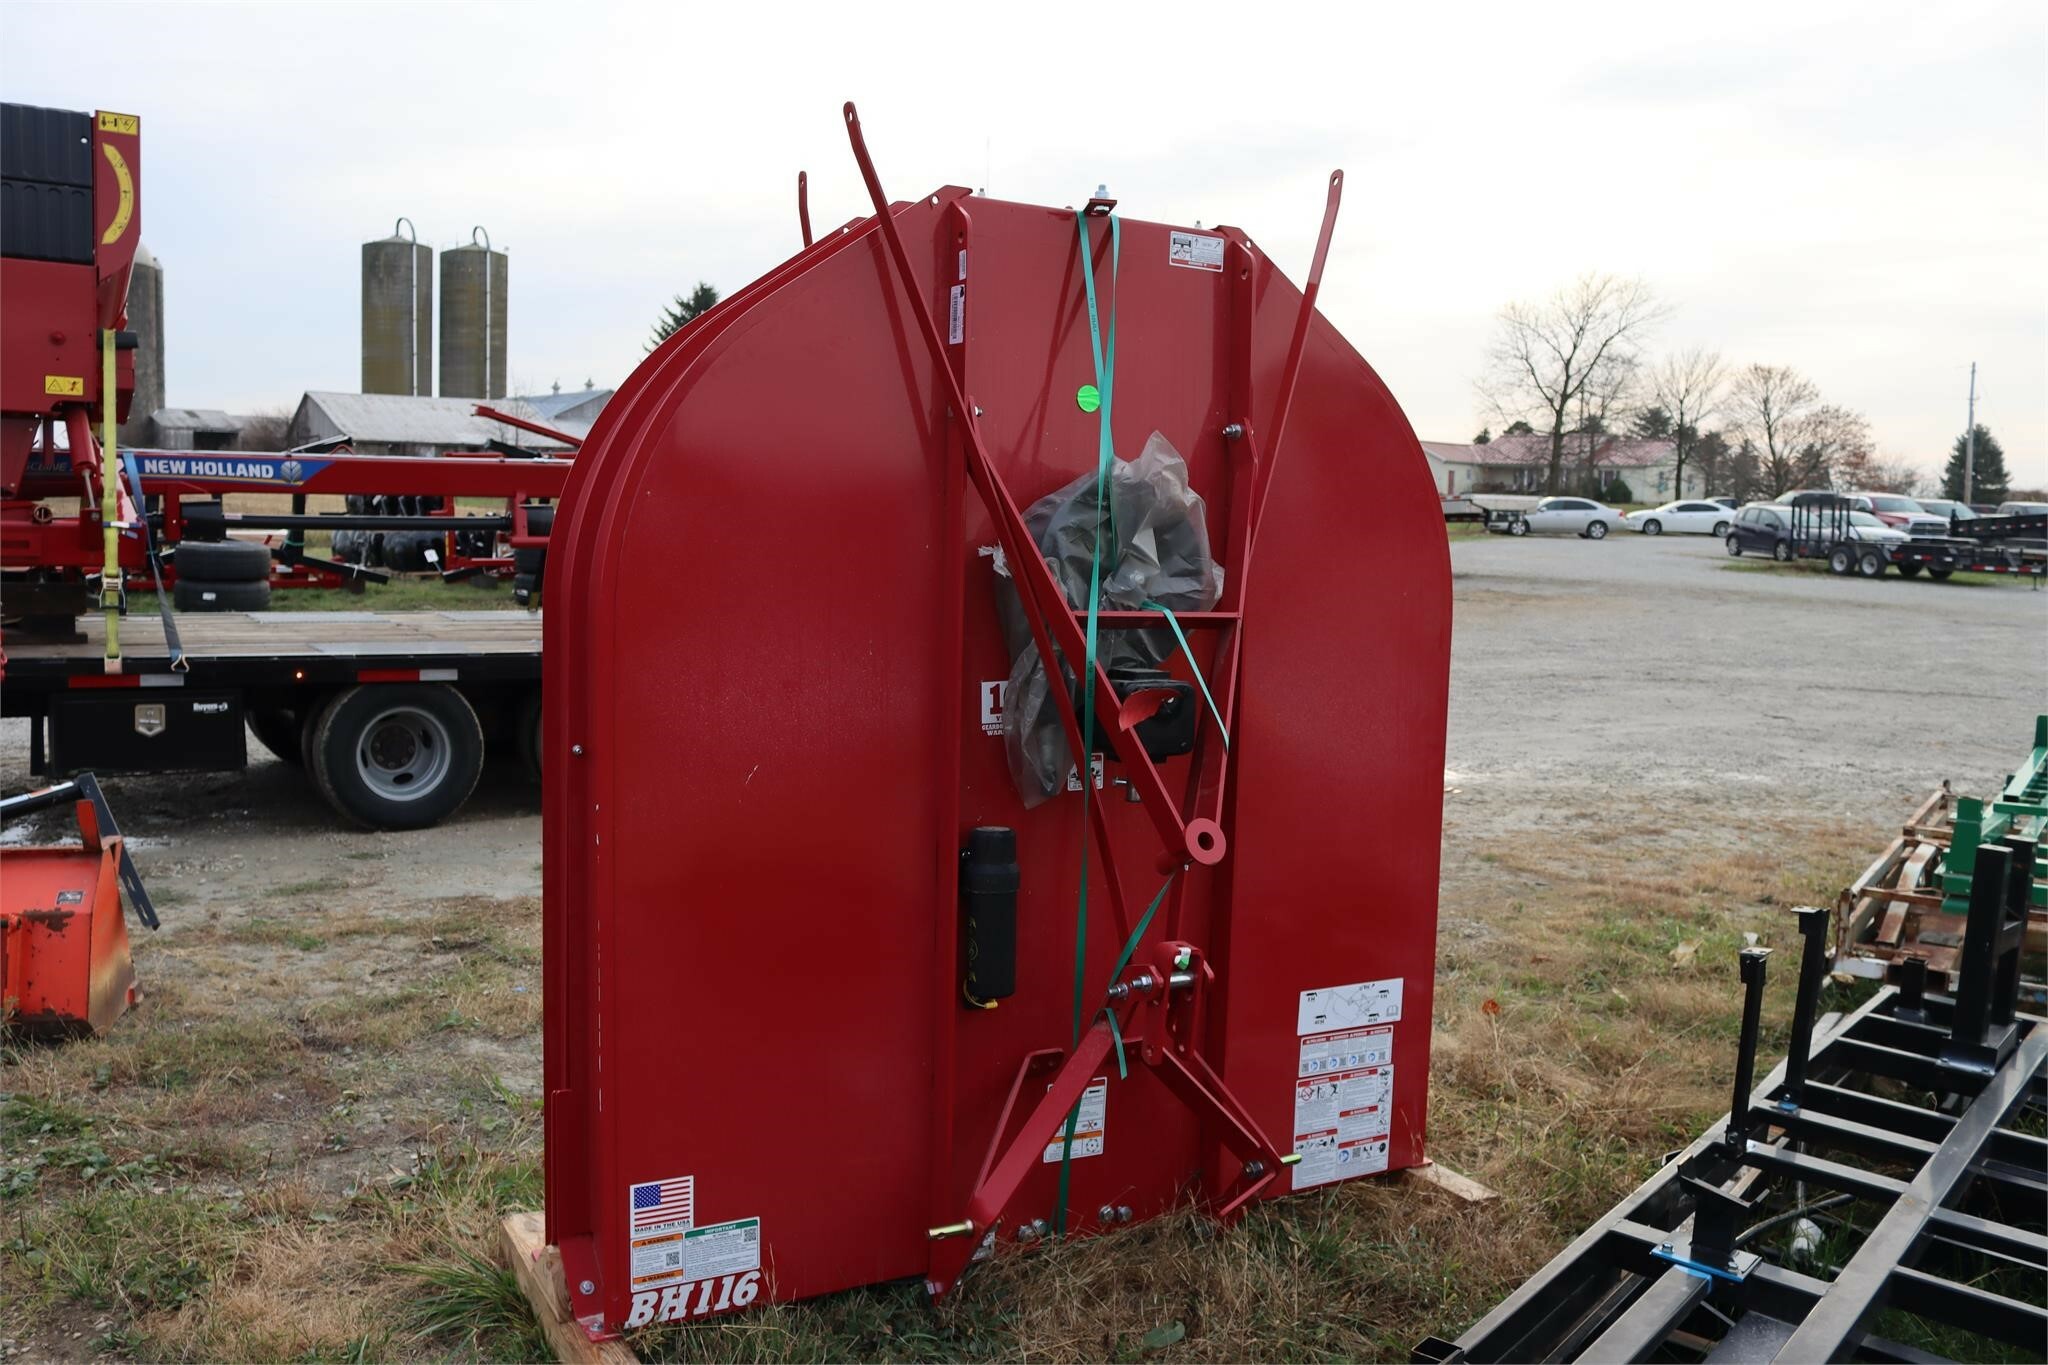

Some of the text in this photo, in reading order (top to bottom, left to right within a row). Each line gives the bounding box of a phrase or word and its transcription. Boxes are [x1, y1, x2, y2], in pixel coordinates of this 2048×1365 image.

[145, 459, 274, 479] NEW HOLLAND
[704, 1224, 737, 1234] IMPORTANT
[648, 1272, 675, 1281] WARNING
[624, 1271, 761, 1330] BH116
